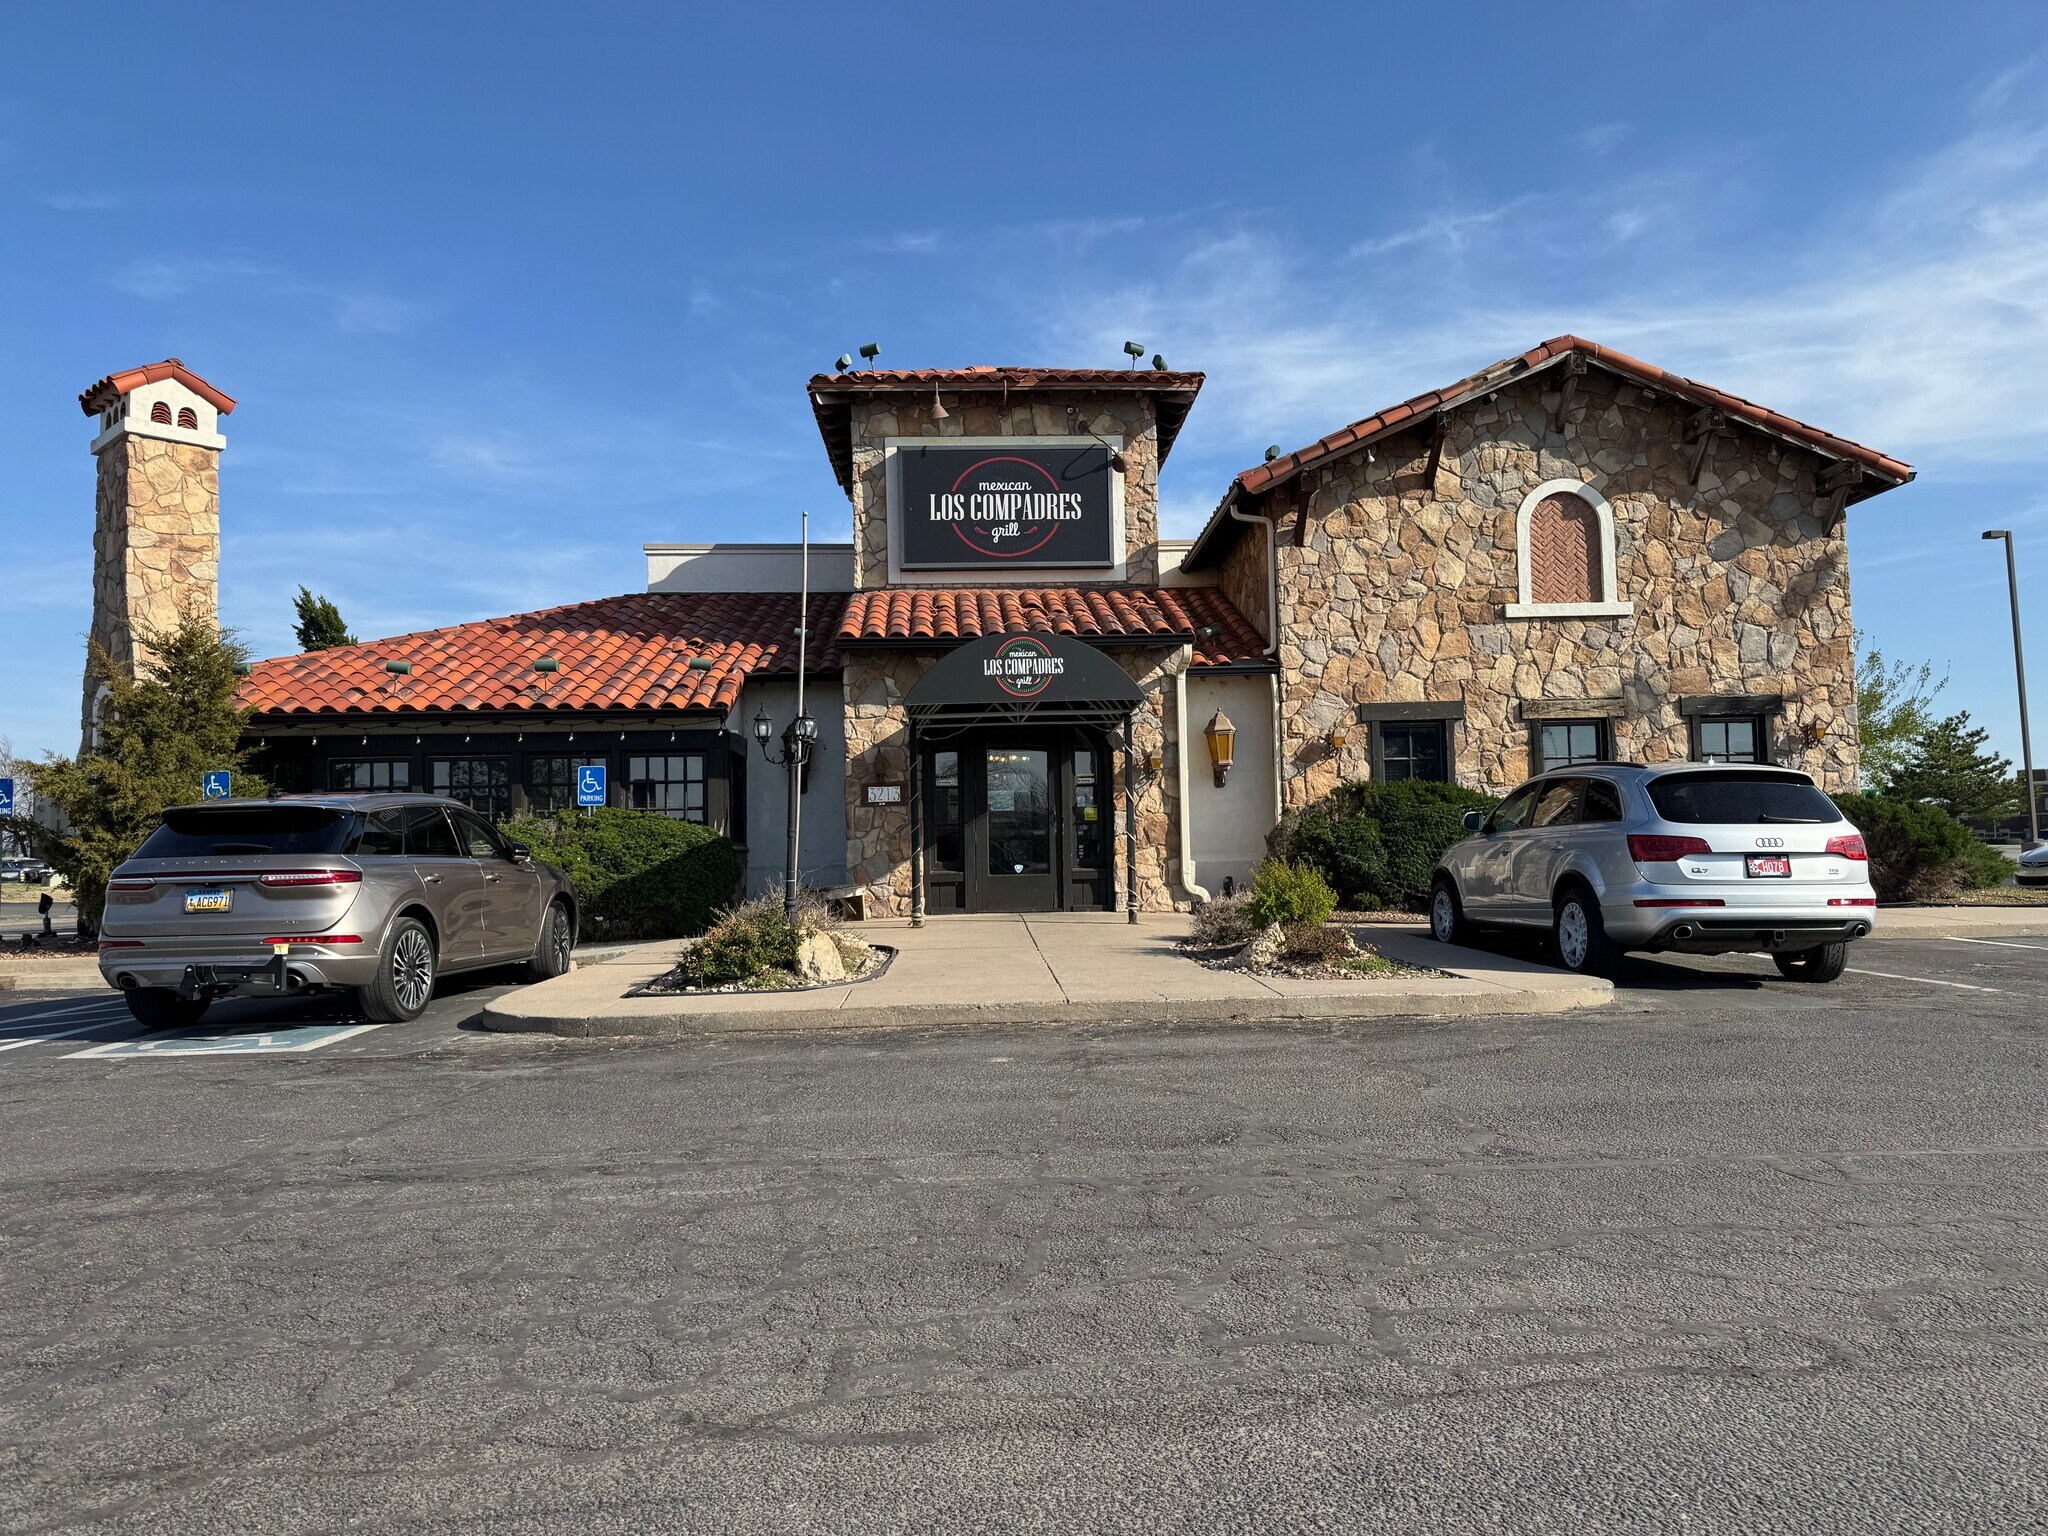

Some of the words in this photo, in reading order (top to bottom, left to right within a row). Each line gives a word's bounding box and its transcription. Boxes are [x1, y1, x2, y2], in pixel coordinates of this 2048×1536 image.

[978, 481, 1032, 491] mexican
[929, 493, 965, 521] LOS
[970, 493, 1082, 520] COMPADRES
[991, 522, 1020, 543] grill
[983, 659, 1003, 676] LOS
[1005, 657, 1064, 675] COMPADRES
[1015, 676, 1032, 688] grill
[869, 787, 900, 801] 3213
